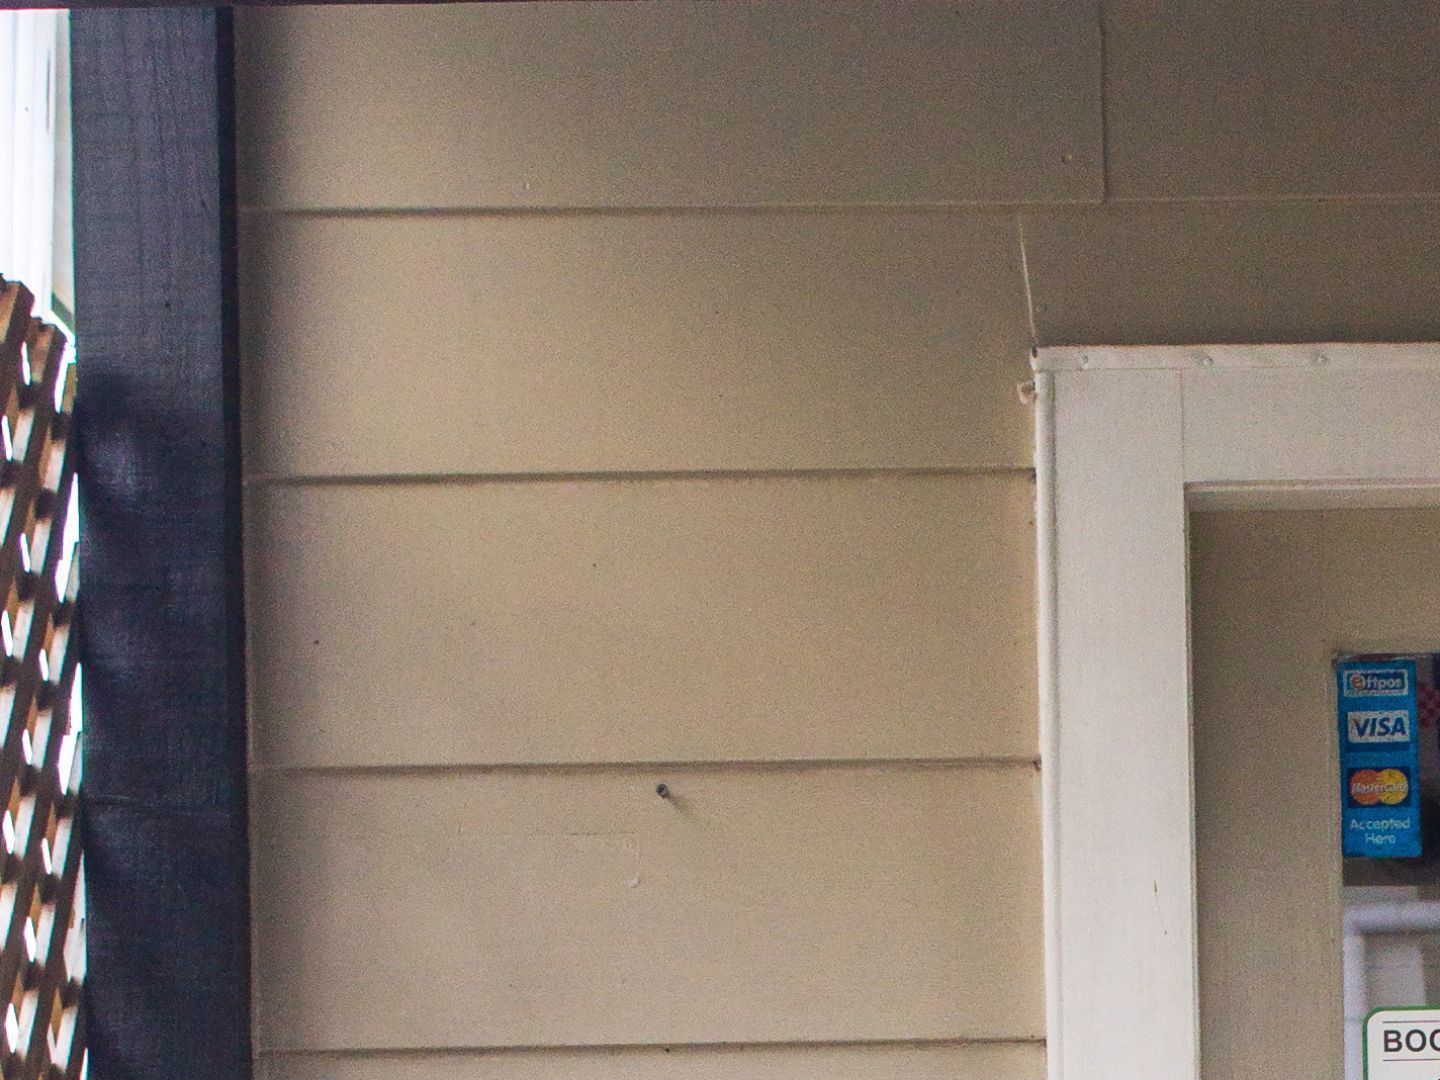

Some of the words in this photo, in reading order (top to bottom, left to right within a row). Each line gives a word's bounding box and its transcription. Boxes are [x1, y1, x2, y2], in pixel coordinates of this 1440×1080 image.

[1353, 717, 1406, 736] VISA
[1350, 818, 1410, 831] Accepted
[1365, 832, 1396, 844] Here
